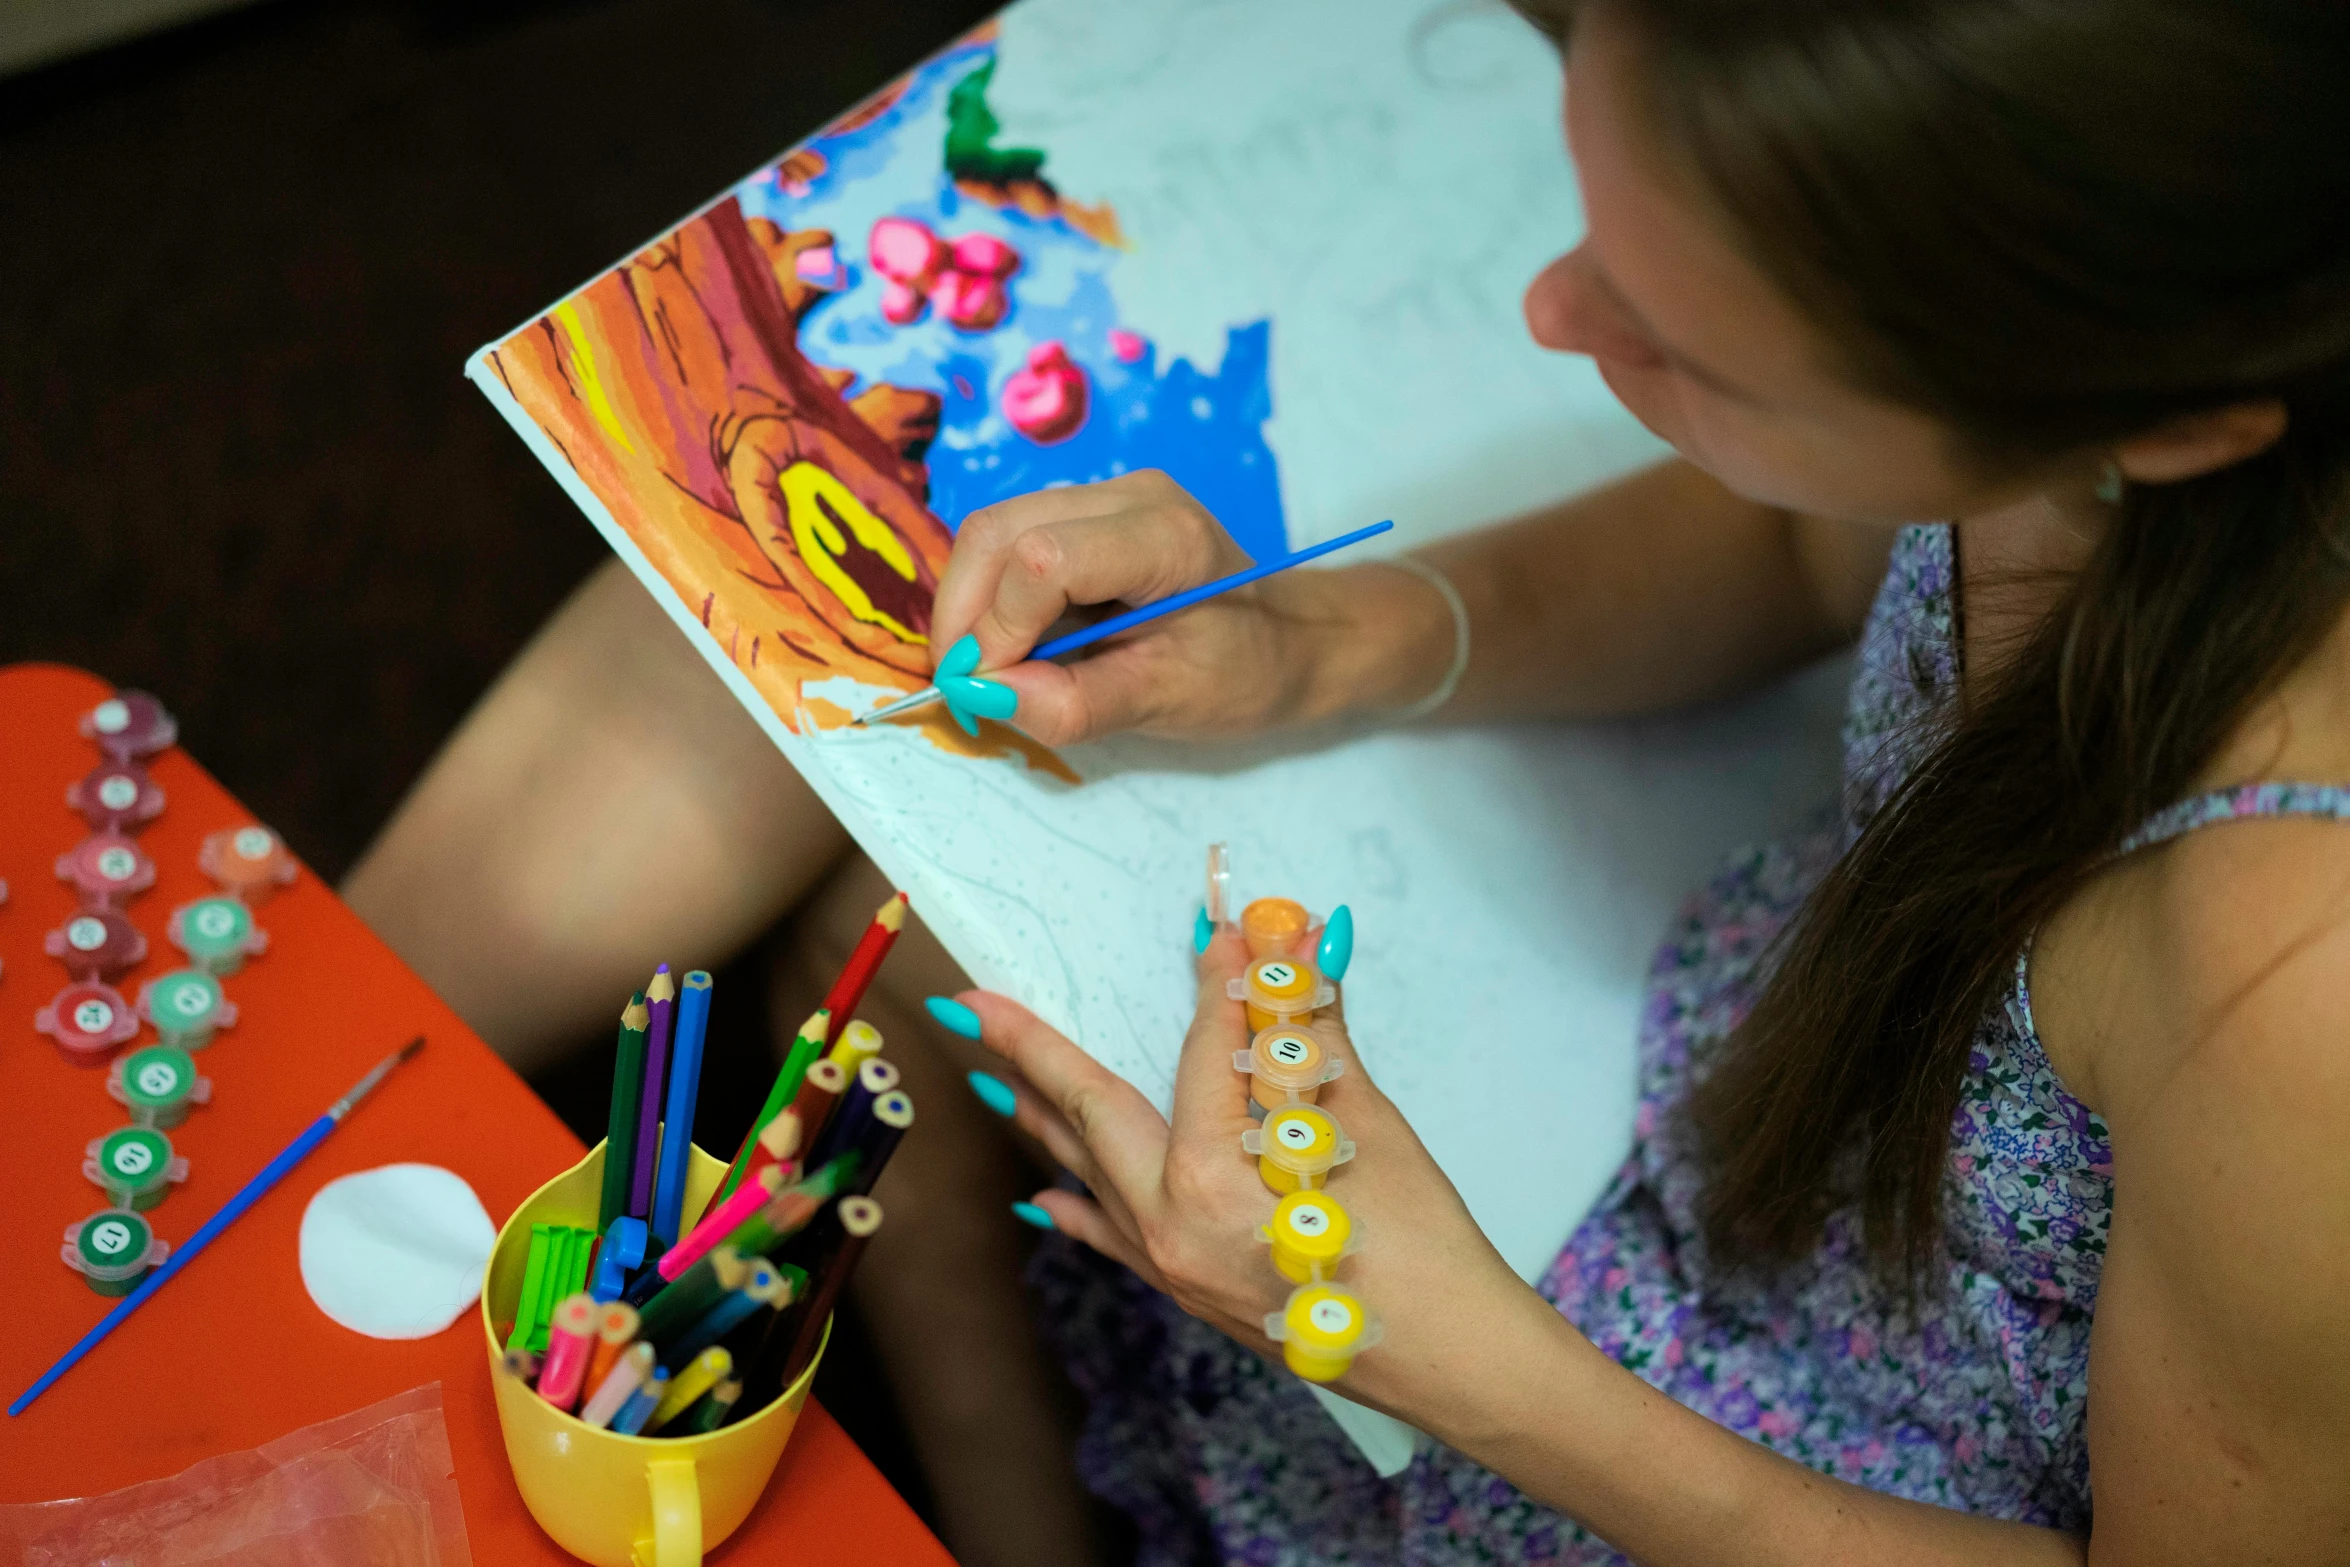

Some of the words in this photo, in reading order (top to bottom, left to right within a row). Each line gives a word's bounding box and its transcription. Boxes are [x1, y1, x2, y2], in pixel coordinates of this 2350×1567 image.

[1265, 967, 1289, 983] 11
[1279, 1042, 1301, 1060] 10
[122, 1148, 145, 1167] 16
[1300, 1214, 1319, 1226] 8
[101, 1228, 122, 1249] 17
